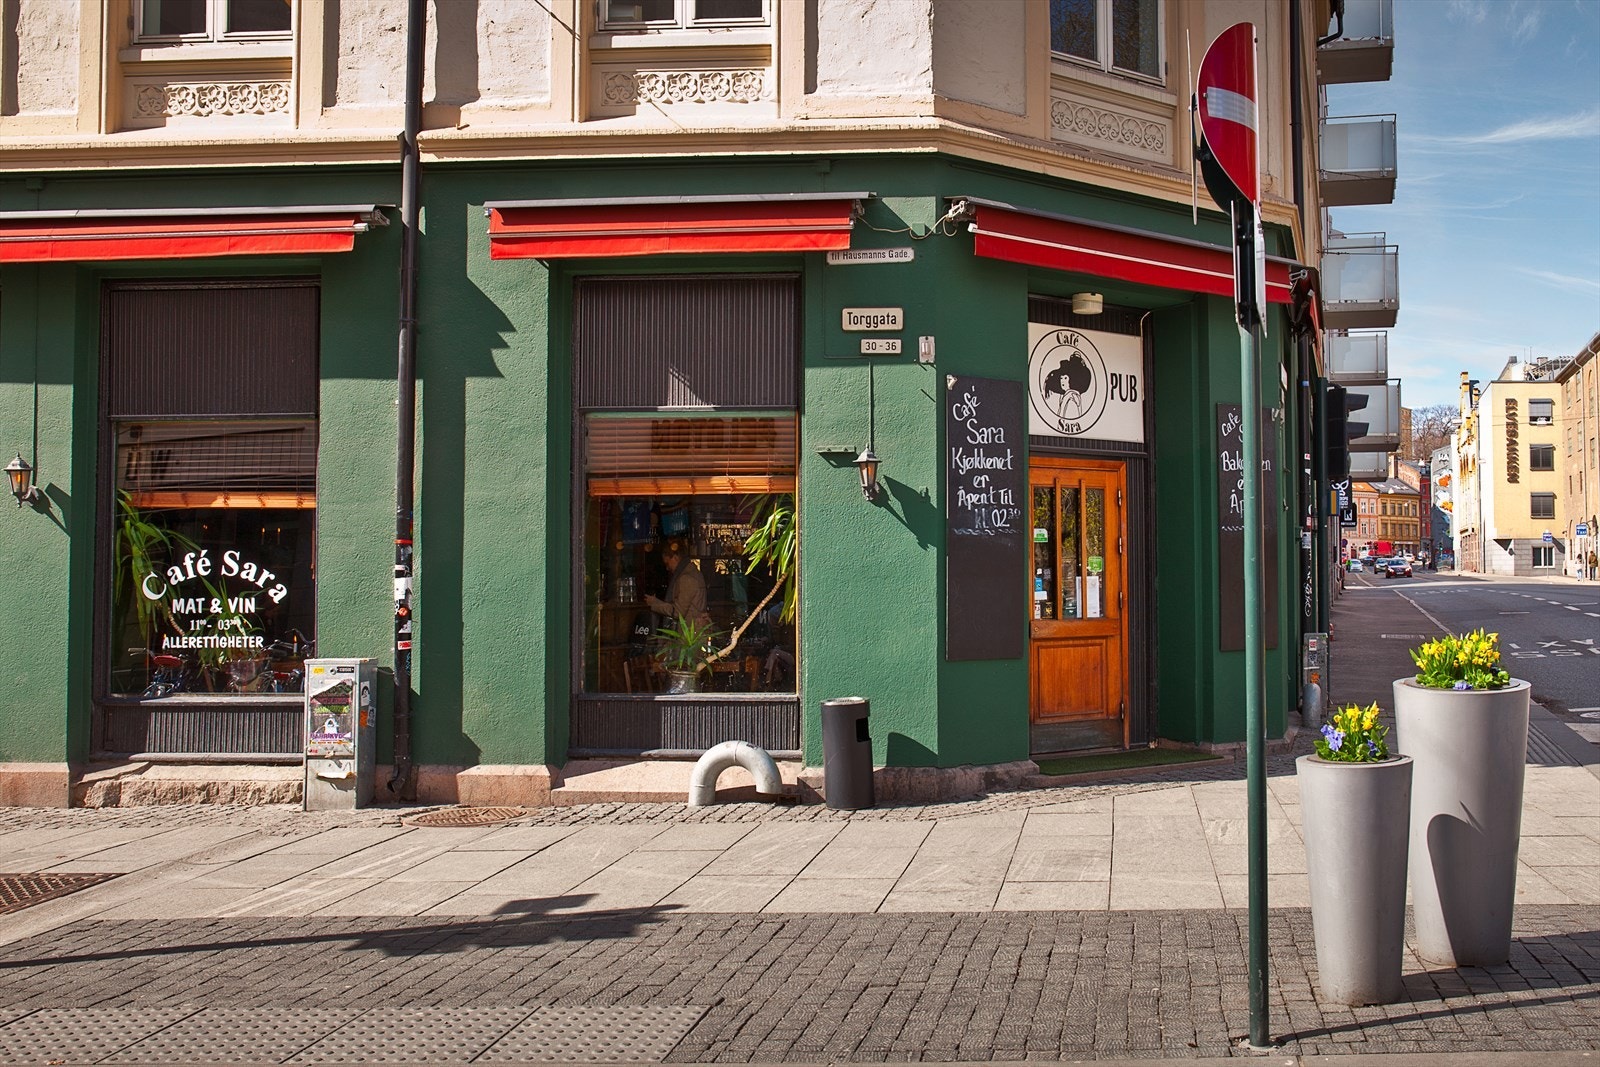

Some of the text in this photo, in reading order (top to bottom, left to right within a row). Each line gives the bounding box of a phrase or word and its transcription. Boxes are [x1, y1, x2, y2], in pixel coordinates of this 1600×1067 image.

[842, 250, 886, 260] Hausmanns
[888, 249, 911, 259] Gade.
[847, 312, 897, 328] Torggata
[865, 342, 877, 351] 30
[885, 342, 897, 351] 36
[1056, 331, 1080, 347] Café
[1110, 372, 1138, 403] PUB
[952, 385, 981, 421] Café
[966, 418, 1005, 444] Sara
[1057, 418, 1082, 433] Sara
[952, 447, 1013, 475] Kjøkkenet
[973, 474, 990, 488] er
[957, 486, 1015, 510] Åpent Til
[142, 550, 288, 604] Café Sara
[172, 597, 256, 615] MAT & VIN
[634, 625, 650, 635] Lee
[162, 636, 264, 649] ALLERETTIGHETER
